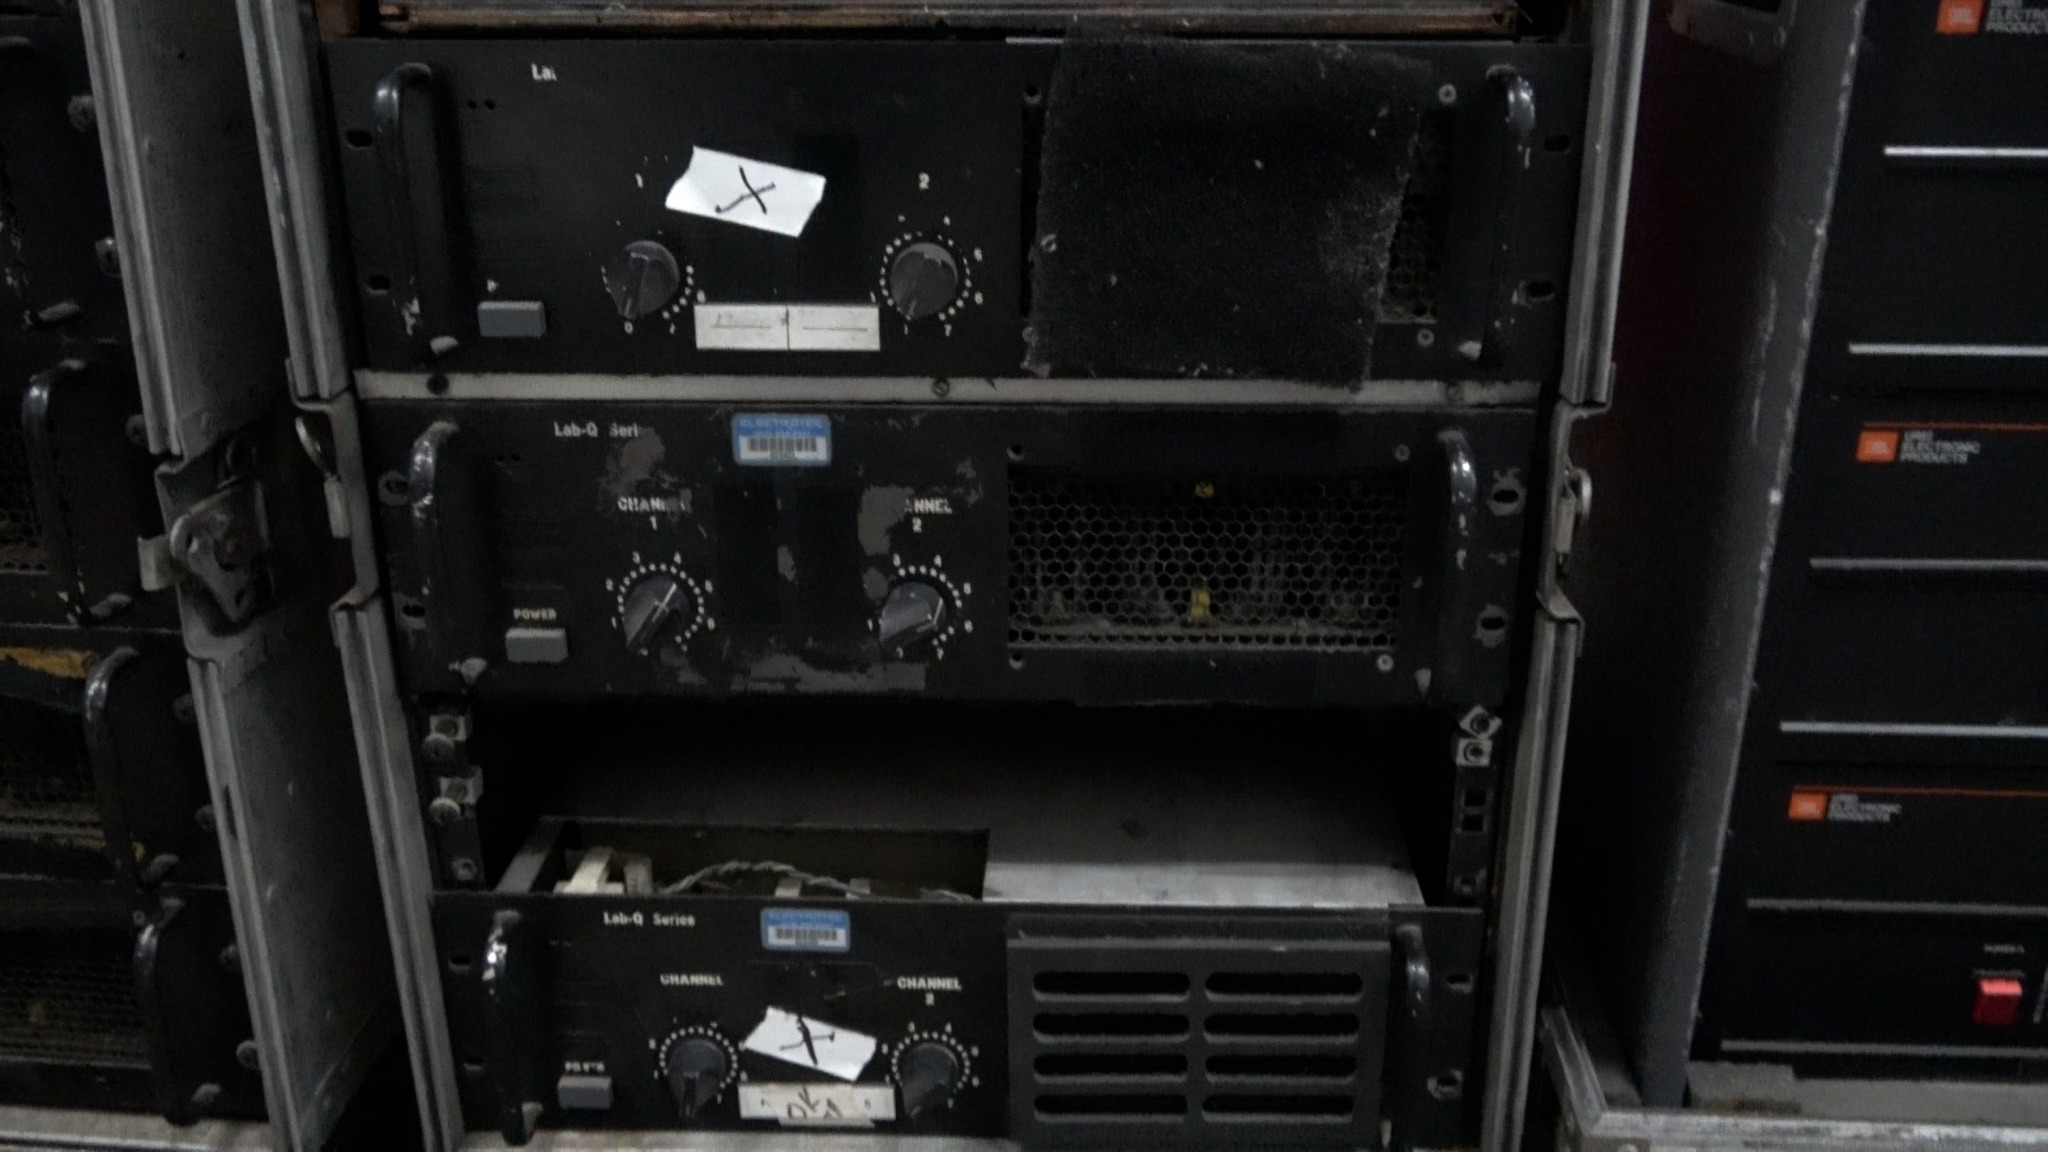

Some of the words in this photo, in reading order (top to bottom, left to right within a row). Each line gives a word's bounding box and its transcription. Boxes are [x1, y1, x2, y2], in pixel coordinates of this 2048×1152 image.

[554, 420, 598, 437] Lab-Q
[513, 608, 557, 621] POWER
[603, 911, 643, 927] Lab-Q
[652, 912, 695, 927] Series
[897, 976, 962, 991] CHANNEL
